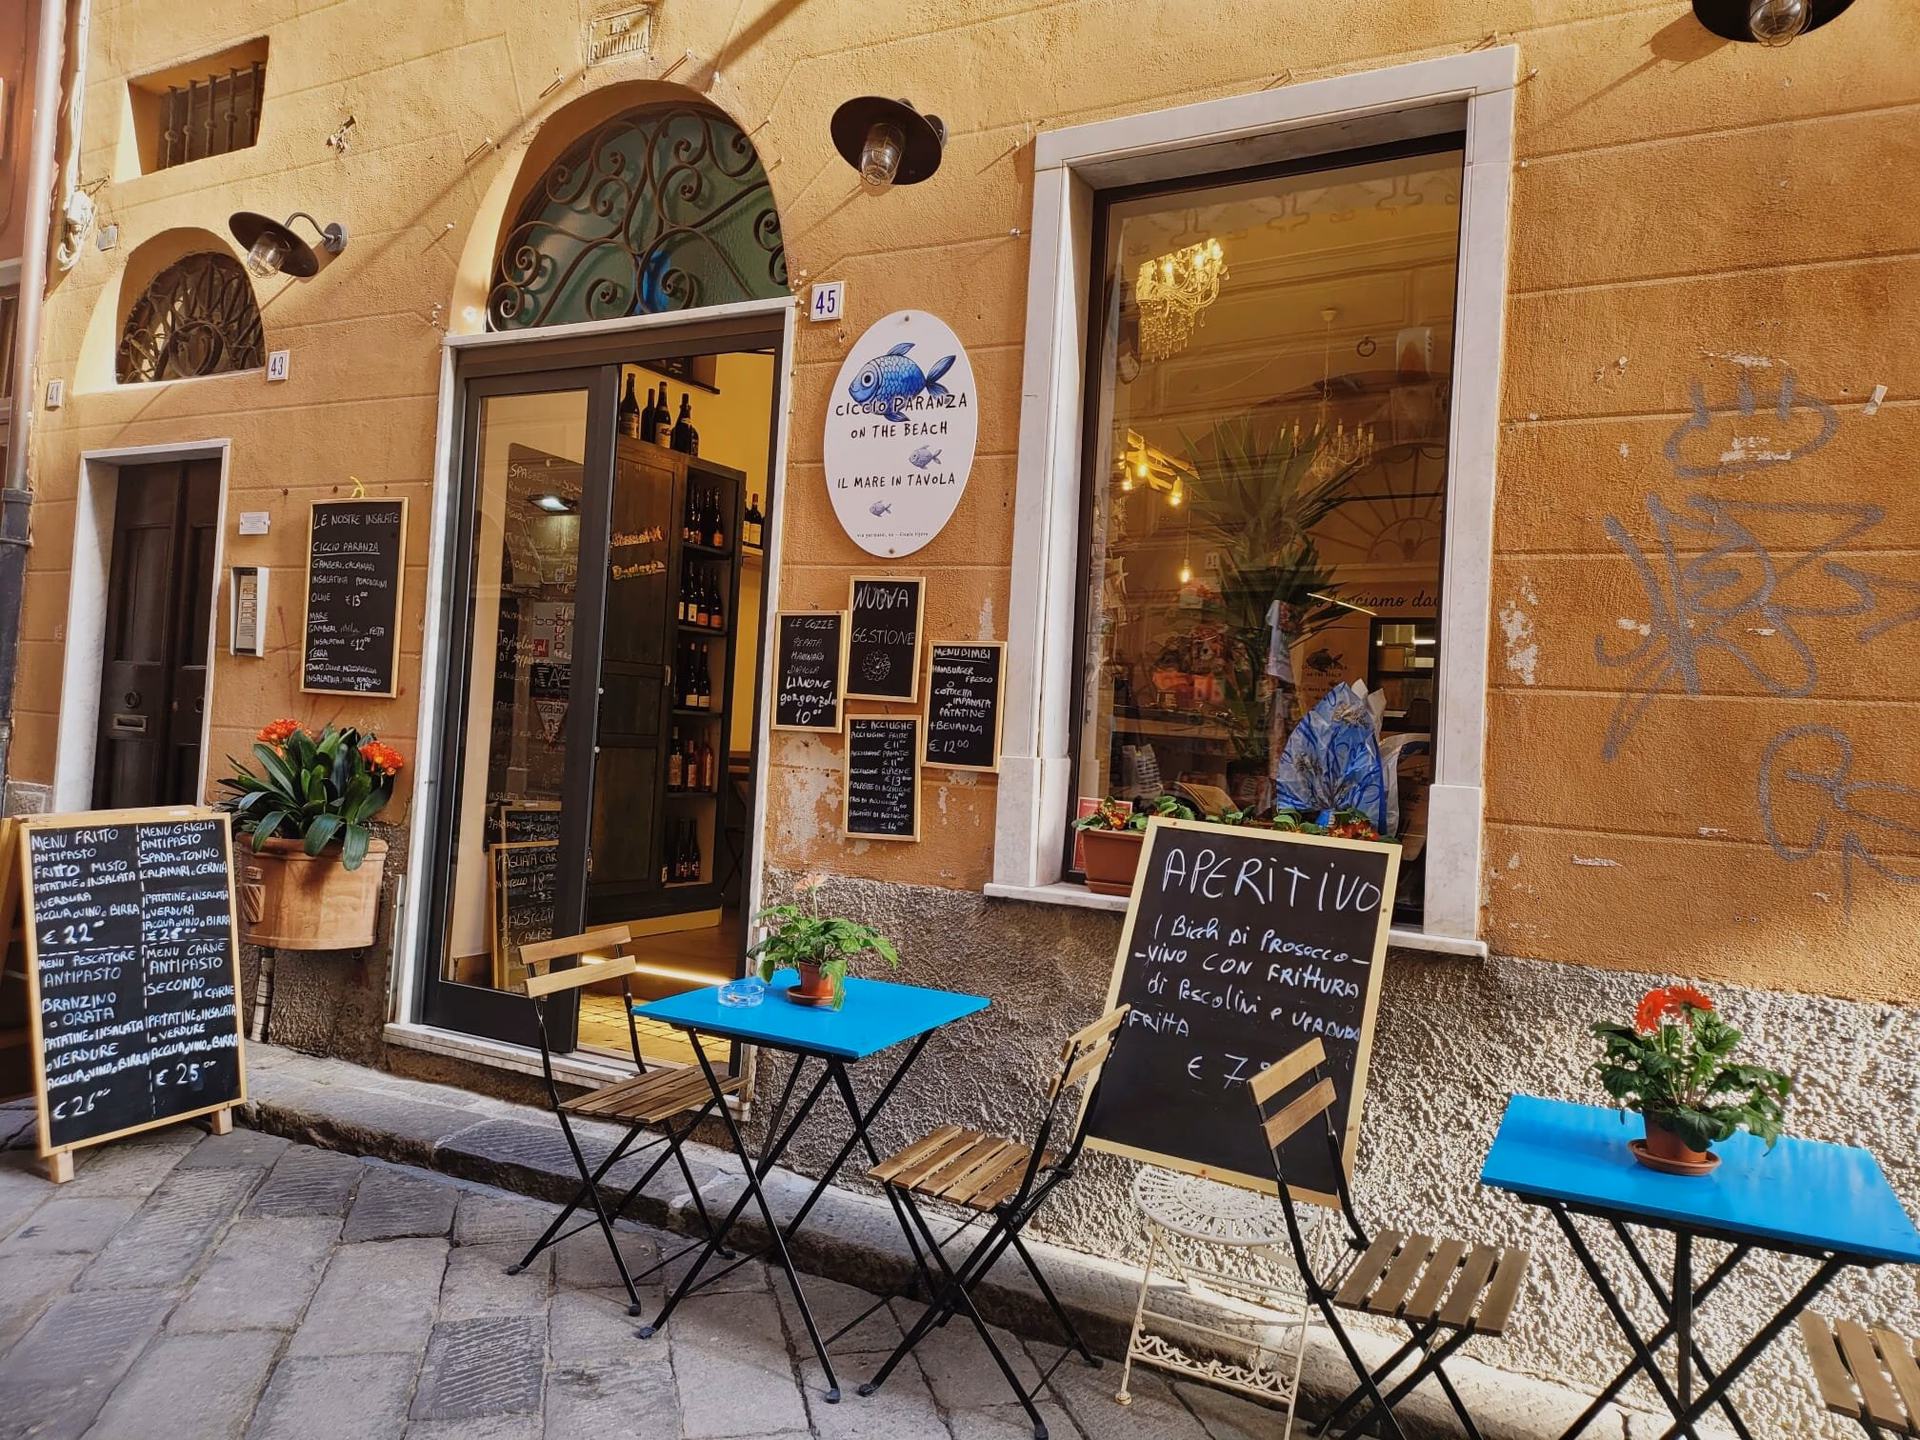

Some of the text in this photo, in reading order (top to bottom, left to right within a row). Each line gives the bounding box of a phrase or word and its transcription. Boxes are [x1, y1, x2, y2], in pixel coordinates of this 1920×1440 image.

[609, 20, 630, 35] LA
[816, 290, 836, 314] 45
[270, 356, 284, 375] 43
[50, 386, 59, 401] 41
[836, 393, 968, 416] CICCIO PARANZA
[851, 421, 948, 439] ON THE BEACH
[838, 472, 956, 489] IL MARE IN TAVOLA
[314, 512, 399, 530] LE NOSTRE INSALATE
[312, 542, 378, 552] CICCIO PARANZA
[854, 583, 908, 610] NUOVA
[790, 618, 834, 630] LE COZZE
[852, 627, 914, 646] GESTIONE
[934, 648, 960, 658] MENU
[933, 665, 974, 674] HAMBURGER
[953, 698, 992, 708] IMPANATA
[940, 708, 986, 718] PATATINE
[870, 721, 914, 730] ACCIUGHE
[141, 820, 216, 838] MENU GRIGLIA
[32, 829, 118, 850] MENU FRITTO
[142, 834, 201, 850] ANTIPASTO
[34, 848, 96, 863] ANTIPASTO
[140, 852, 175, 864] SPADA
[180, 847, 220, 860] TONNO
[34, 860, 128, 880] FRITTO MISTO
[196, 861, 228, 874] CERNIA
[35, 879, 79, 894] PATATINE
[87, 872, 136, 888] INSALATA
[40, 892, 92, 908] VERDURA
[146, 892, 187, 904] PATATINE
[36, 908, 72, 923] ACQUA
[78, 906, 102, 916] VINO
[110, 904, 140, 916] BIRRA
[150, 904, 194, 916] VERDURA
[146, 918, 174, 930] ACQUA
[180, 918, 200, 926] VINO
[206, 915, 230, 926] BIRRA
[41, 930, 58, 944] €
[38, 950, 136, 970] MENU PESCATORE
[147, 942, 226, 960] MENU CARNE
[150, 957, 224, 976] ANTIPASTO
[1202, 953, 1252, 975] CON
[44, 967, 122, 988] ANTIPASTO
[148, 977, 206, 996] SECONDO
[1148, 972, 1168, 995] di
[193, 984, 235, 999] DI CARNE
[42, 992, 116, 1013] BRANZINO
[63, 1007, 114, 1026] ORATA
[148, 1004, 236, 1028] PATATINE INSALATA
[44, 1020, 144, 1053] PATATINE INSALATA
[159, 1023, 206, 1040] VERDURE
[53, 1042, 119, 1068] VERDURE
[152, 1042, 184, 1060] ACQUA
[212, 1034, 238, 1048] BIRRA
[1188, 1056, 1202, 1080] €
[47, 1069, 84, 1091] ACQUA
[156, 1069, 168, 1086] €
[53, 1101, 67, 1120] €
